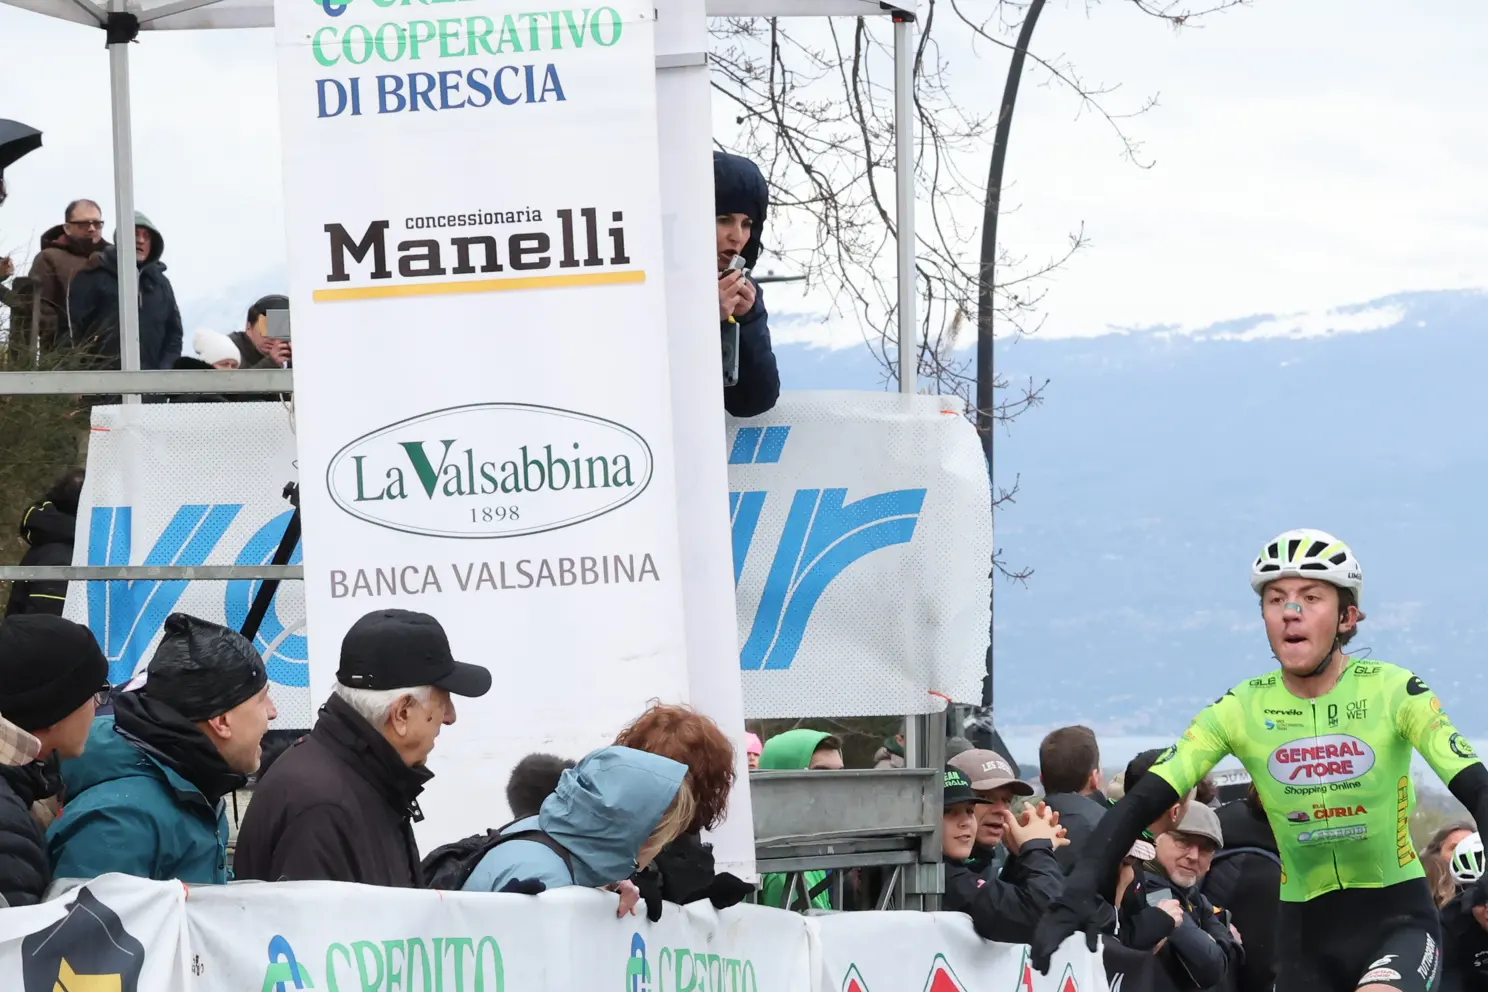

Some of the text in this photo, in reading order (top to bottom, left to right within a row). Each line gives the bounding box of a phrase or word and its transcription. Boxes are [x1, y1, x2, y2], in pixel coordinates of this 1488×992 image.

[312, 6, 623, 67] COOPERATIVO
[315, 63, 567, 118] DI BRESCIA
[405, 206, 542, 230] concessionaria
[324, 207, 631, 282] Manelli
[469, 504, 521, 524] 1898
[329, 552, 661, 599] BANCA VALSABBINA
[1275, 740, 1365, 764] GENERAL
[1289, 760, 1354, 780] STORE
[1284, 779, 1362, 796] Shopping Online
[1313, 805, 1368, 819] CURIA
